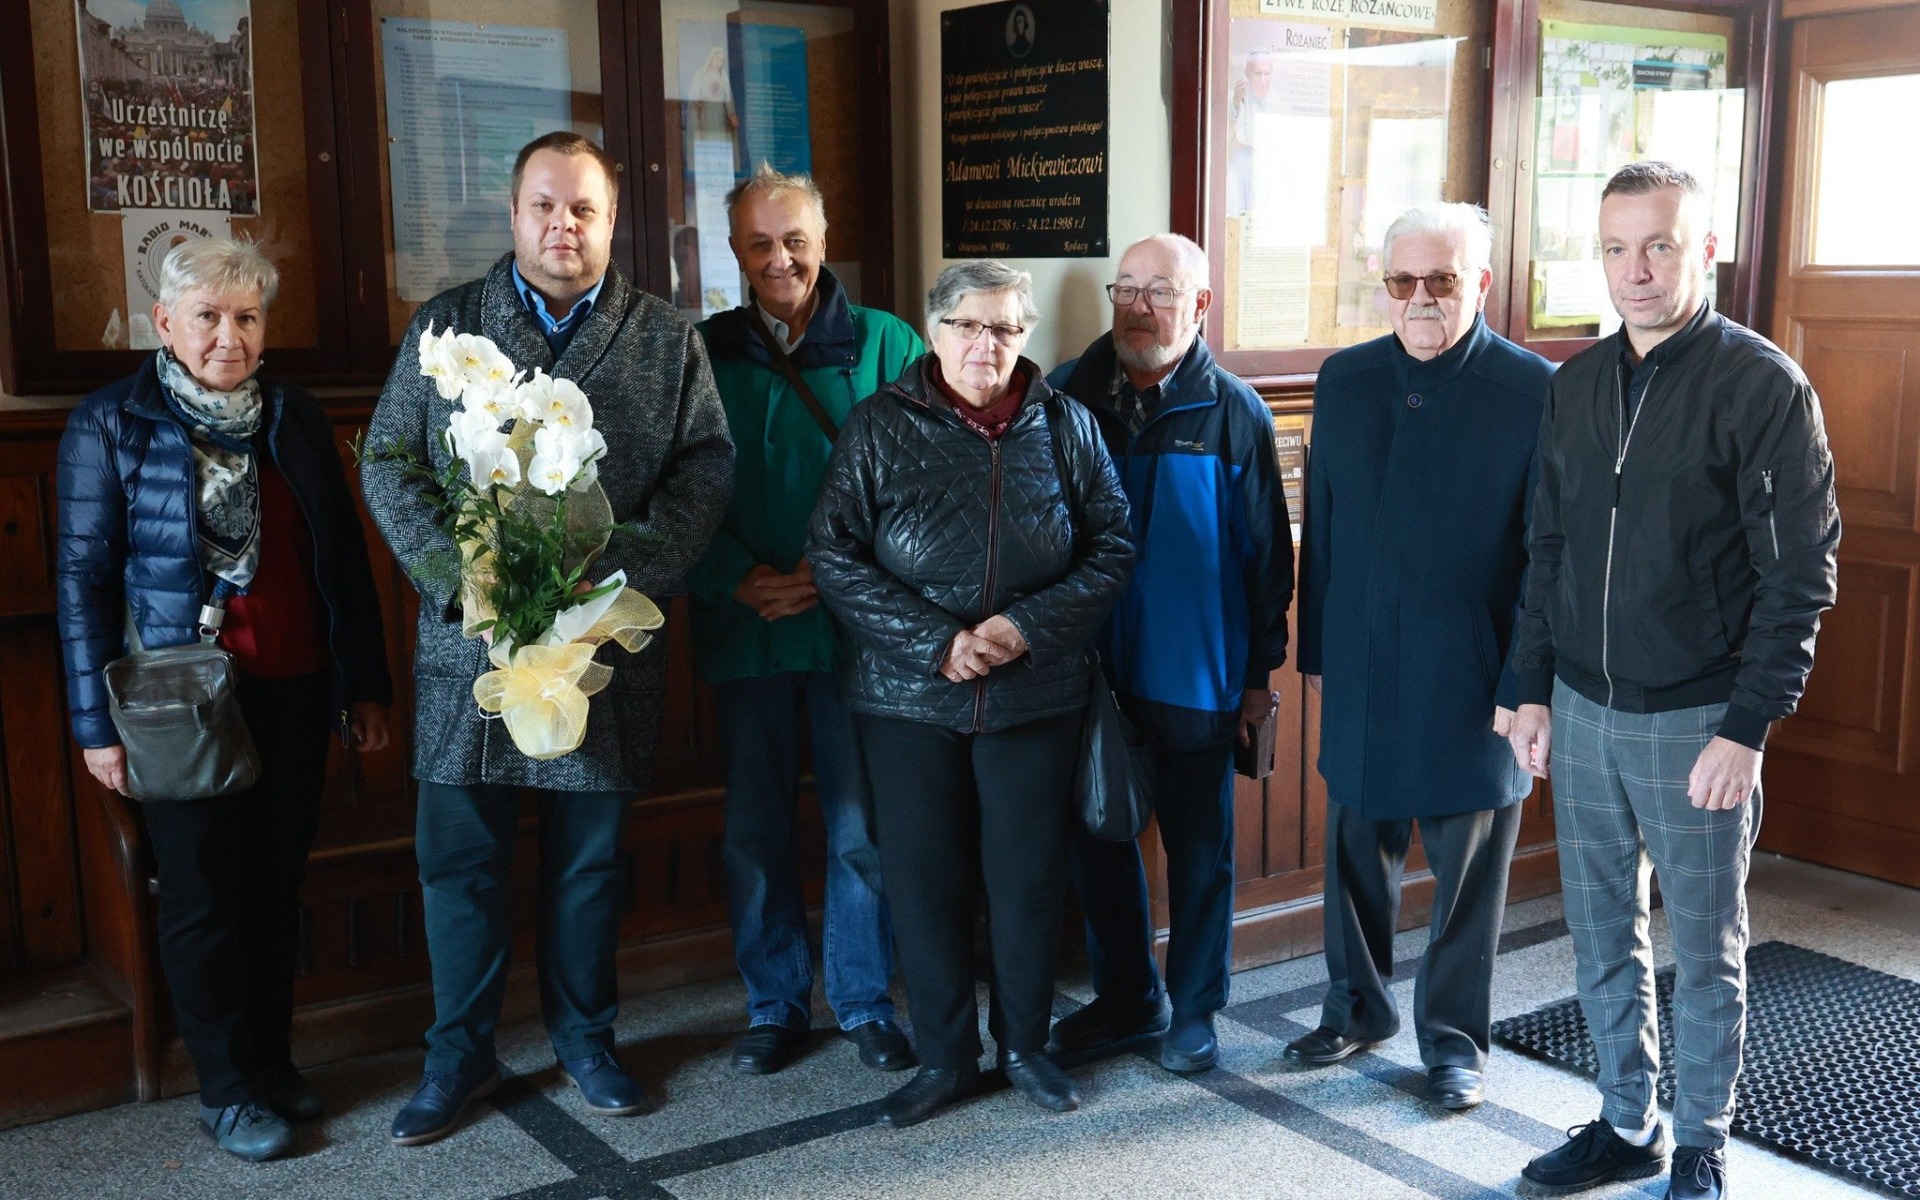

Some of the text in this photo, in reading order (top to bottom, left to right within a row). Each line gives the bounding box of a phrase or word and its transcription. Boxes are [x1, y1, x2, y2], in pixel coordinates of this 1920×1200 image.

[112, 98, 228, 134] Uczestniczę
[99, 135, 243, 163] we wspólnocie
[946, 152, 1103, 182] Adamowi Mickiewiczowi
[117, 170, 232, 209] KOŚCIOŁA
[1014, 196, 1046, 209] rocznicę
[1049, 192, 1080, 207] urodzin
[138, 222, 170, 255] RADIO
[1027, 217, 1072, 230] 24.12.1998
